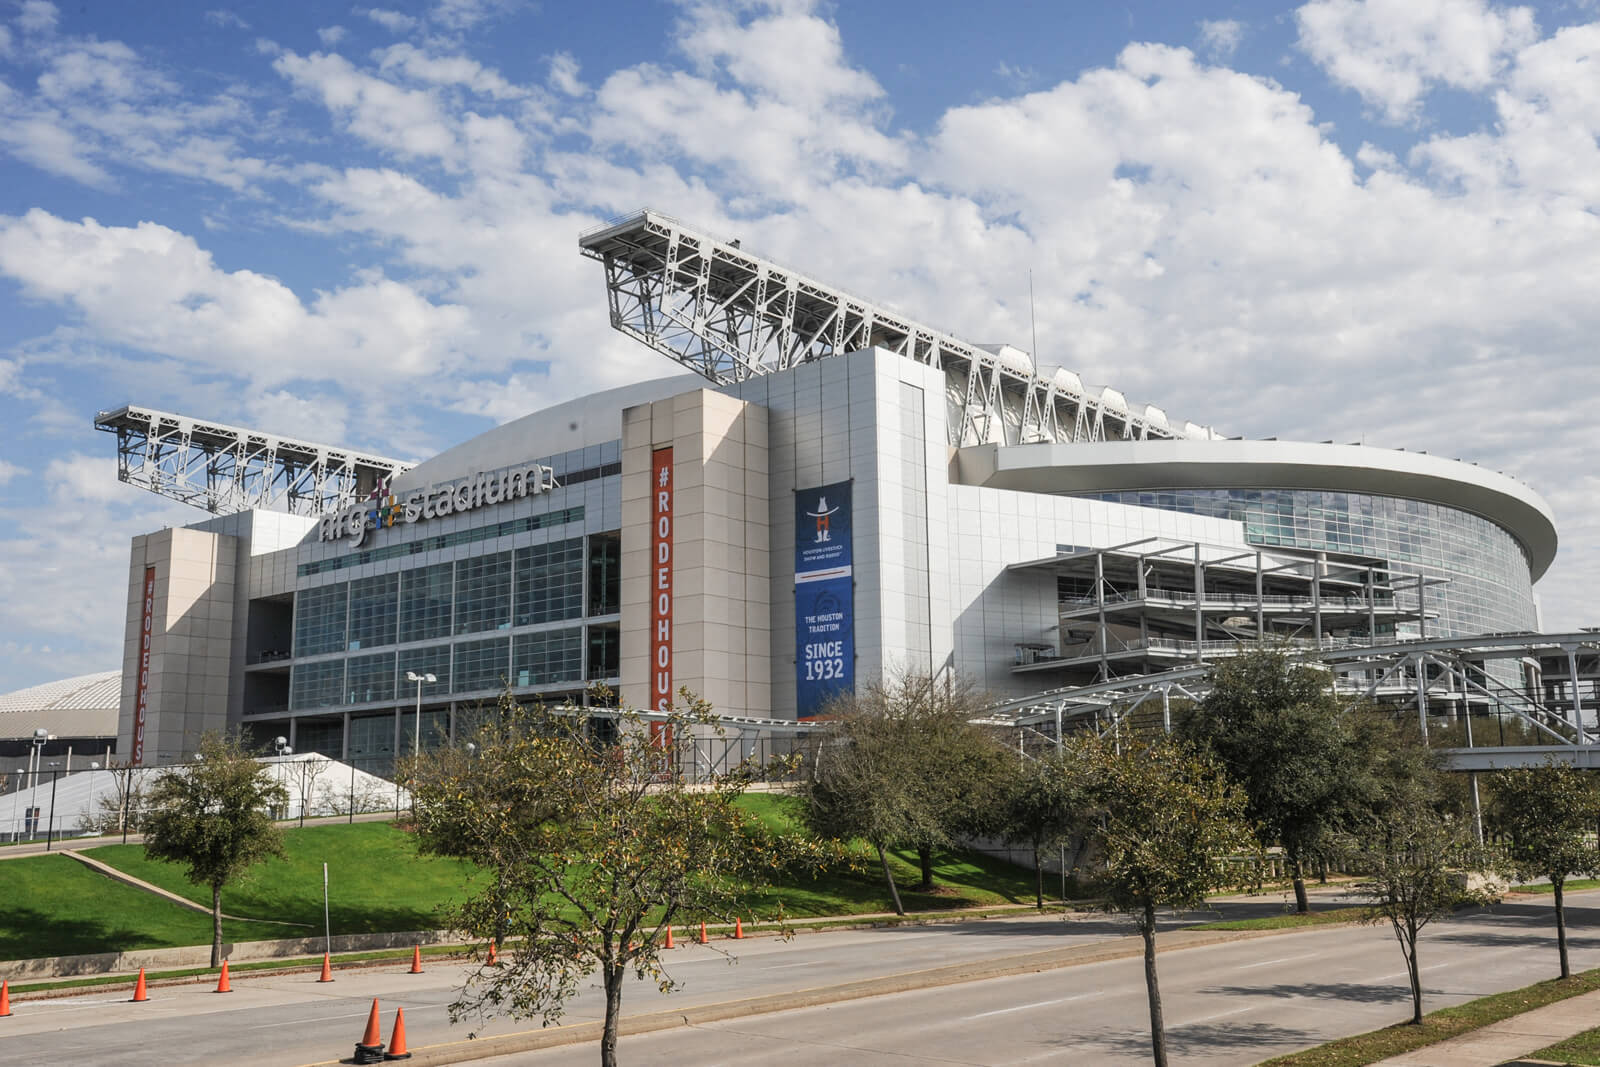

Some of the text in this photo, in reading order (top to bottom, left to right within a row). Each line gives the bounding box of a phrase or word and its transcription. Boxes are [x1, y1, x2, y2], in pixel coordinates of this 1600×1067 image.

[319, 463, 543, 547] nrg stadium
[805, 612, 843, 624] THE HOUSTON
[808, 623, 840, 633] TRADITION
[805, 640, 843, 659] SINCE
[805, 658, 844, 680] 1932
